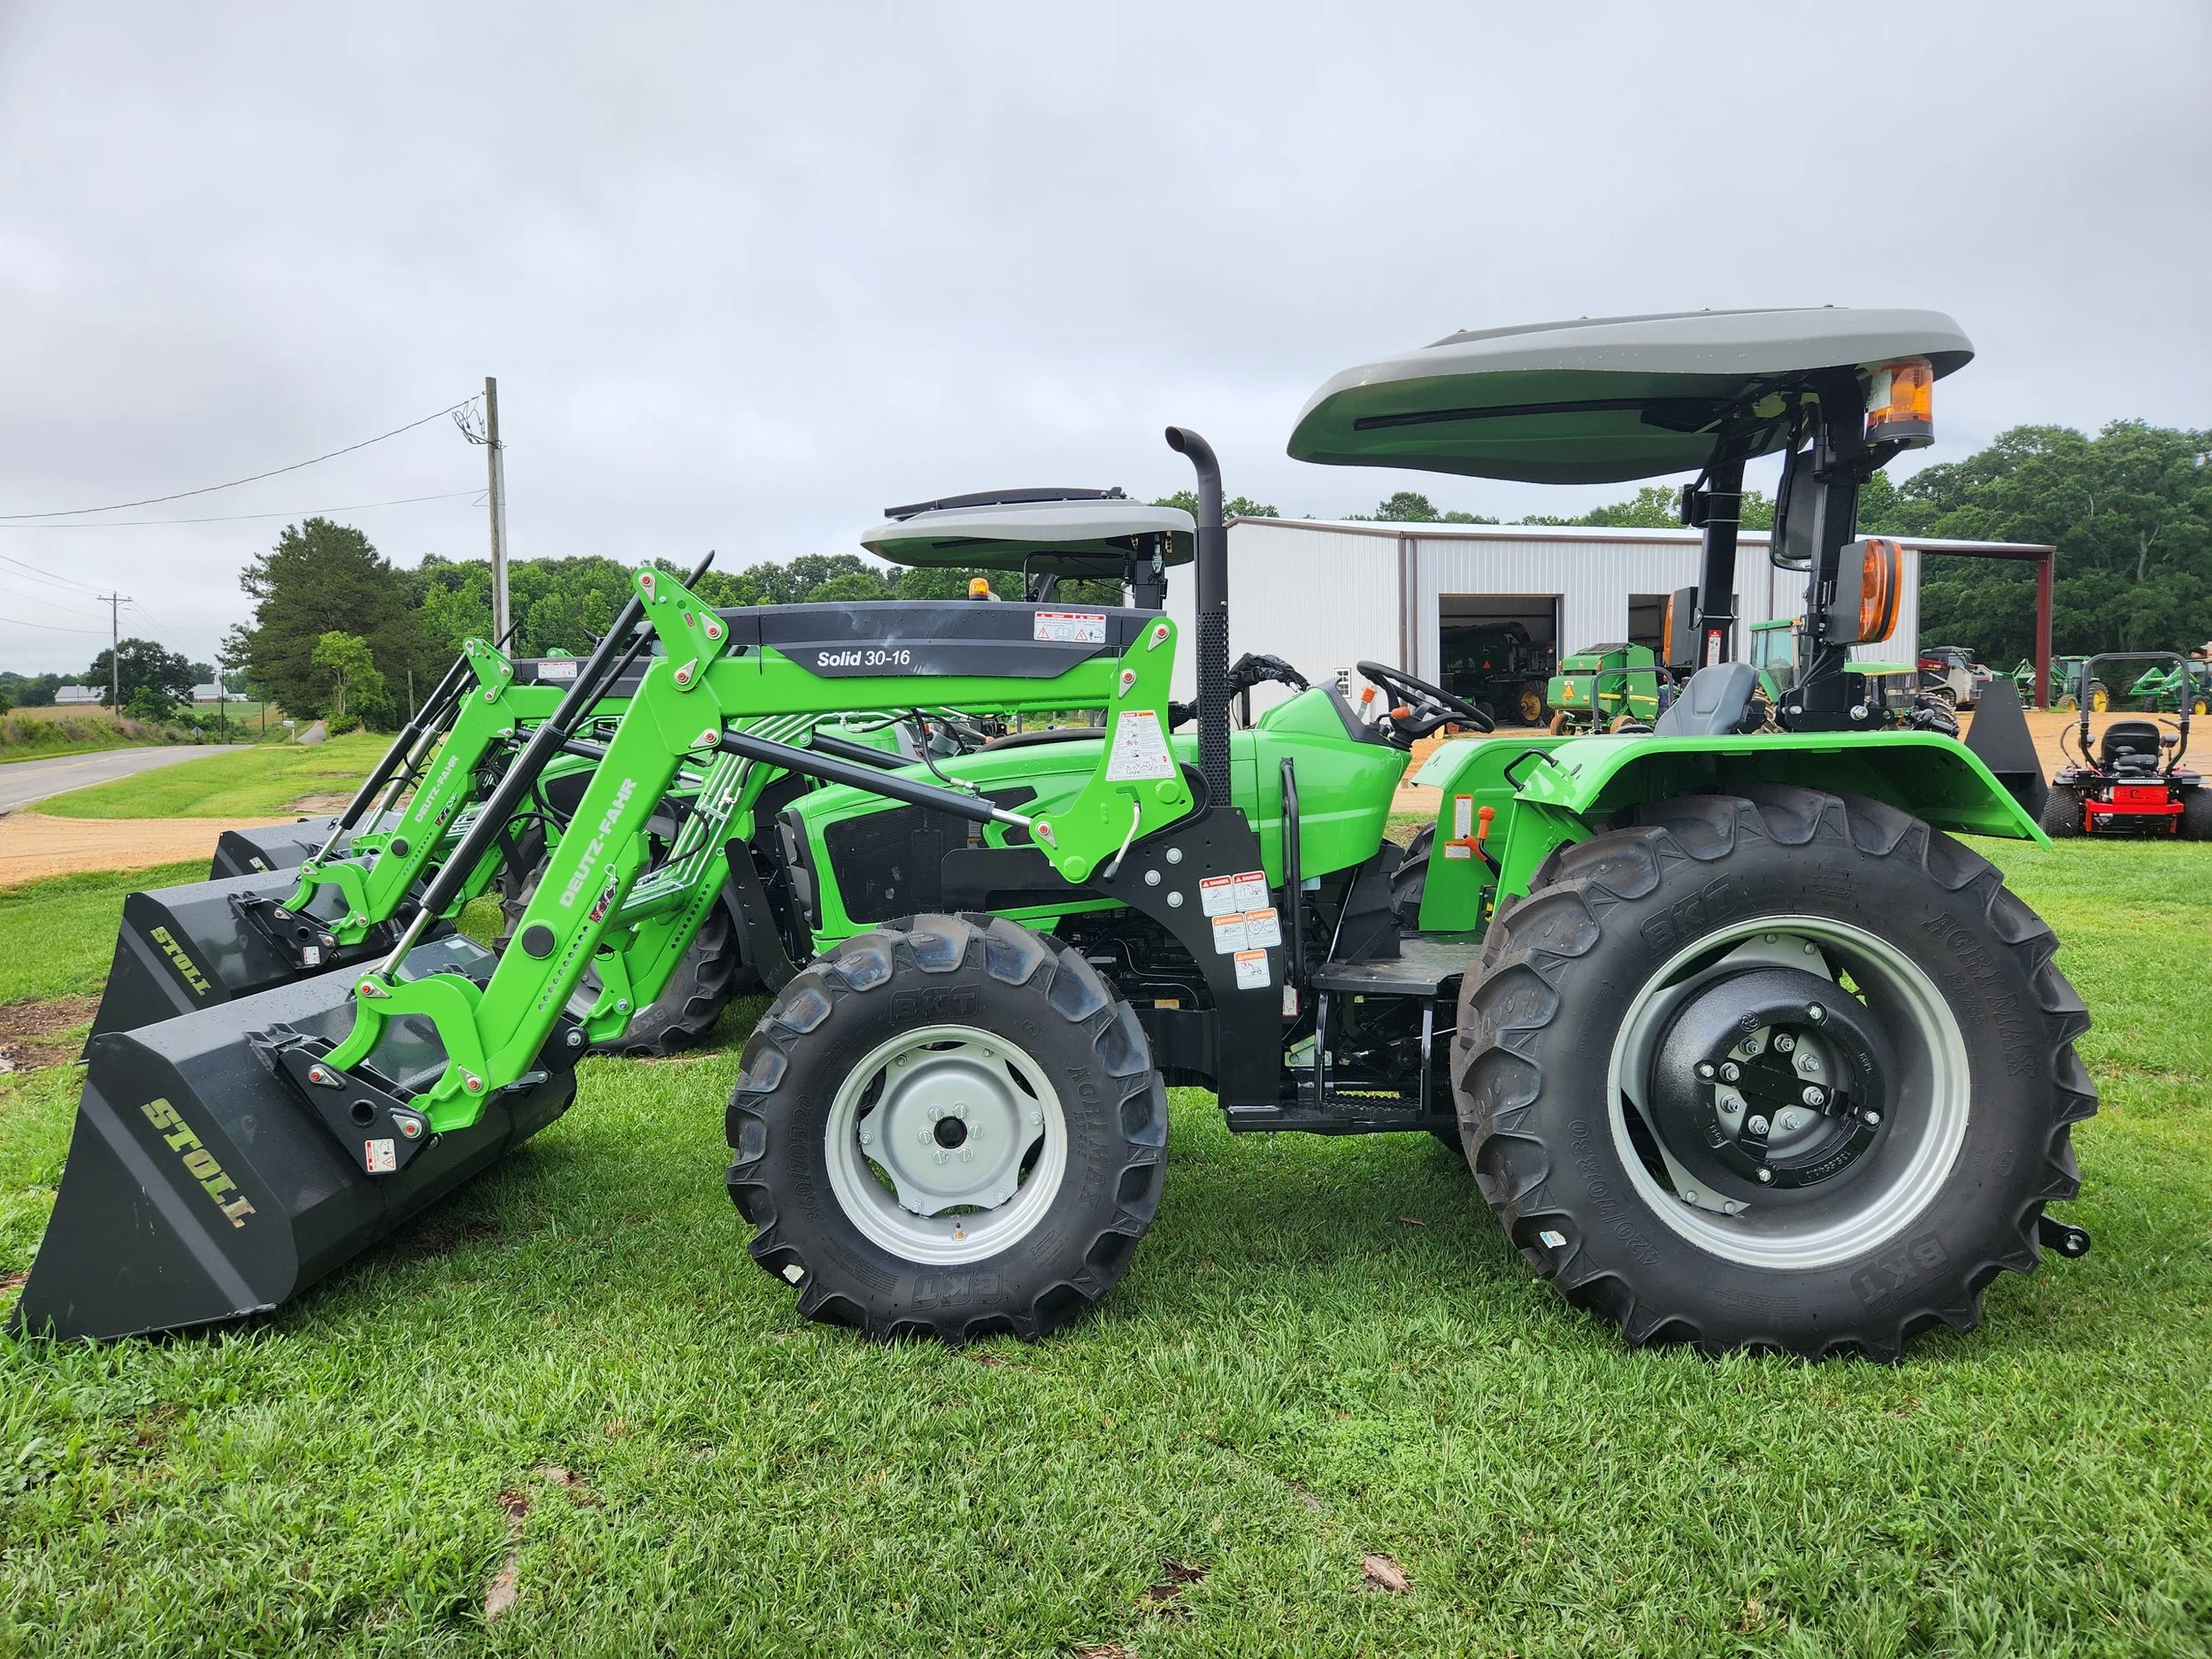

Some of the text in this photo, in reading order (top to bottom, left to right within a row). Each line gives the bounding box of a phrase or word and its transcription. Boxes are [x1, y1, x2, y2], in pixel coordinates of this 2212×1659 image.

[817, 649, 910, 666] Solid 30-16
[414, 755, 458, 823] DEUTZ-FAHR
[559, 778, 637, 908] DEUTZ-FAHR
[149, 926, 212, 997] STOLL
[140, 1097, 257, 1229] STOLL
